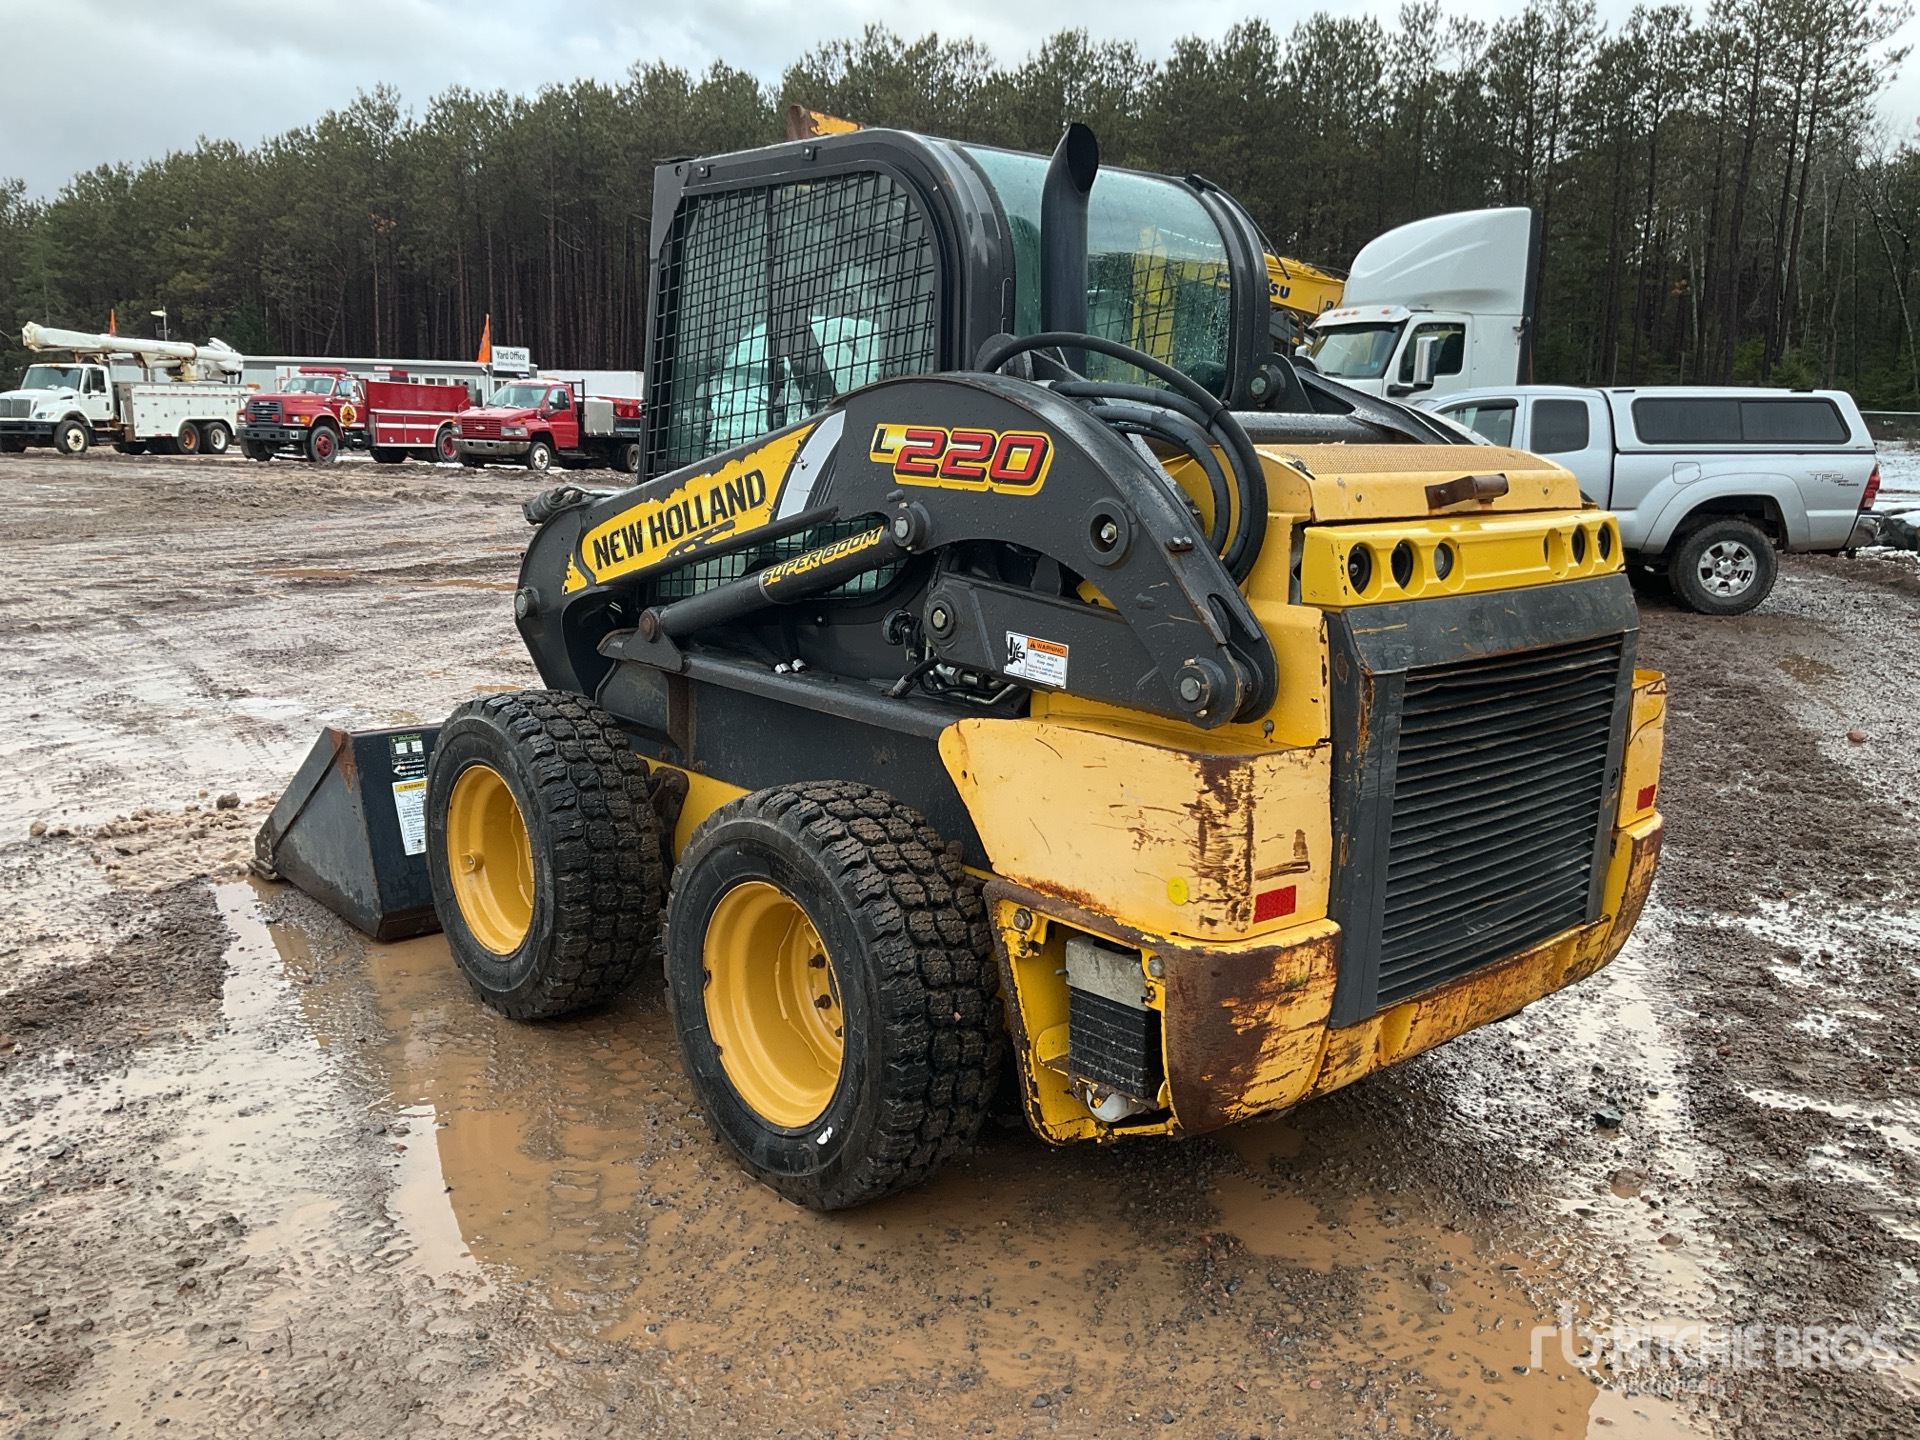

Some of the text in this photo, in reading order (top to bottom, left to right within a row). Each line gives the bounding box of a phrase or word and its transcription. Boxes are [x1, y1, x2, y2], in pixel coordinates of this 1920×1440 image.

[496, 350, 526, 361] Yard Office
[870, 425, 1053, 490] L220
[1810, 472, 1844, 482] TRD
[592, 468, 766, 570] NEW HOLLAND
[763, 527, 884, 584] SUPER BOOM
[1037, 643, 1064, 654] WARNING
[404, 782, 425, 790] WARNING
